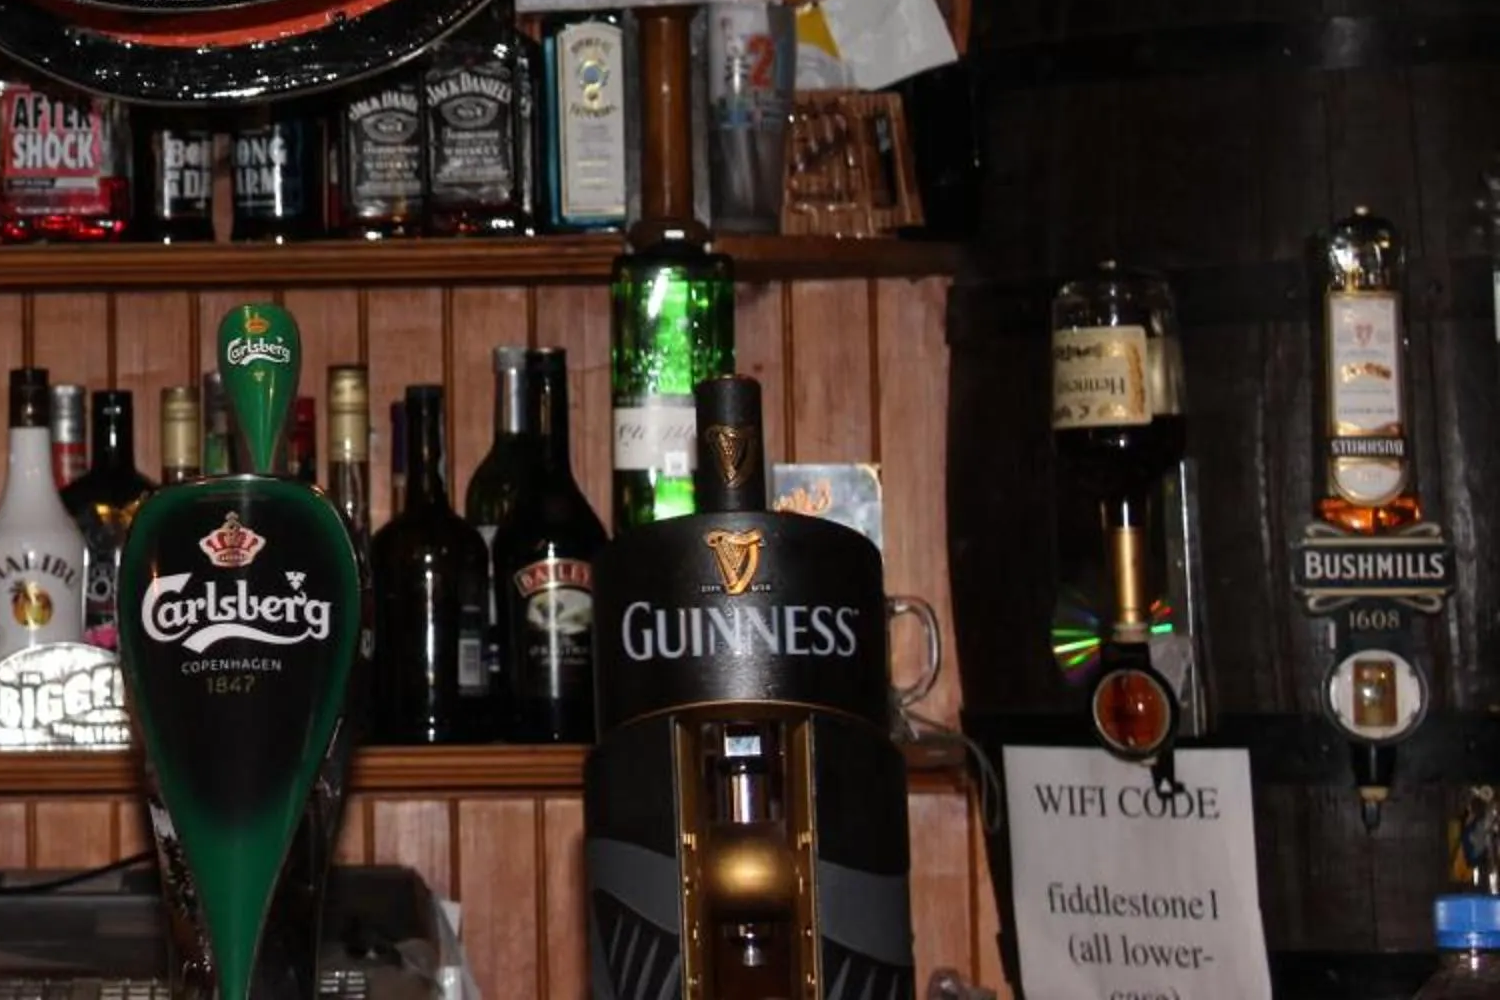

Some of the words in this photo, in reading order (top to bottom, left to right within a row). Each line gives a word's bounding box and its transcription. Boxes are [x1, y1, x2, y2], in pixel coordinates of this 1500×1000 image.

[11, 95, 93, 130] AFTER
[12, 132, 95, 169] SHOCK
[226, 336, 292, 364] Carlsberg
[1304, 550, 1447, 580] BUSHMILLS
[141, 571, 333, 645] Carlsberg
[1347, 609, 1401, 631] 1608
[621, 600, 859, 662] GUINNESS
[180, 656, 284, 677] COPENHAGEN
[204, 676, 257, 695] 1847
[1034, 783, 1109, 819] WIFI
[1118, 784, 1222, 820] CODE
[1068, 932, 1112, 966] (all
[1121, 934, 1215, 969] lower-
